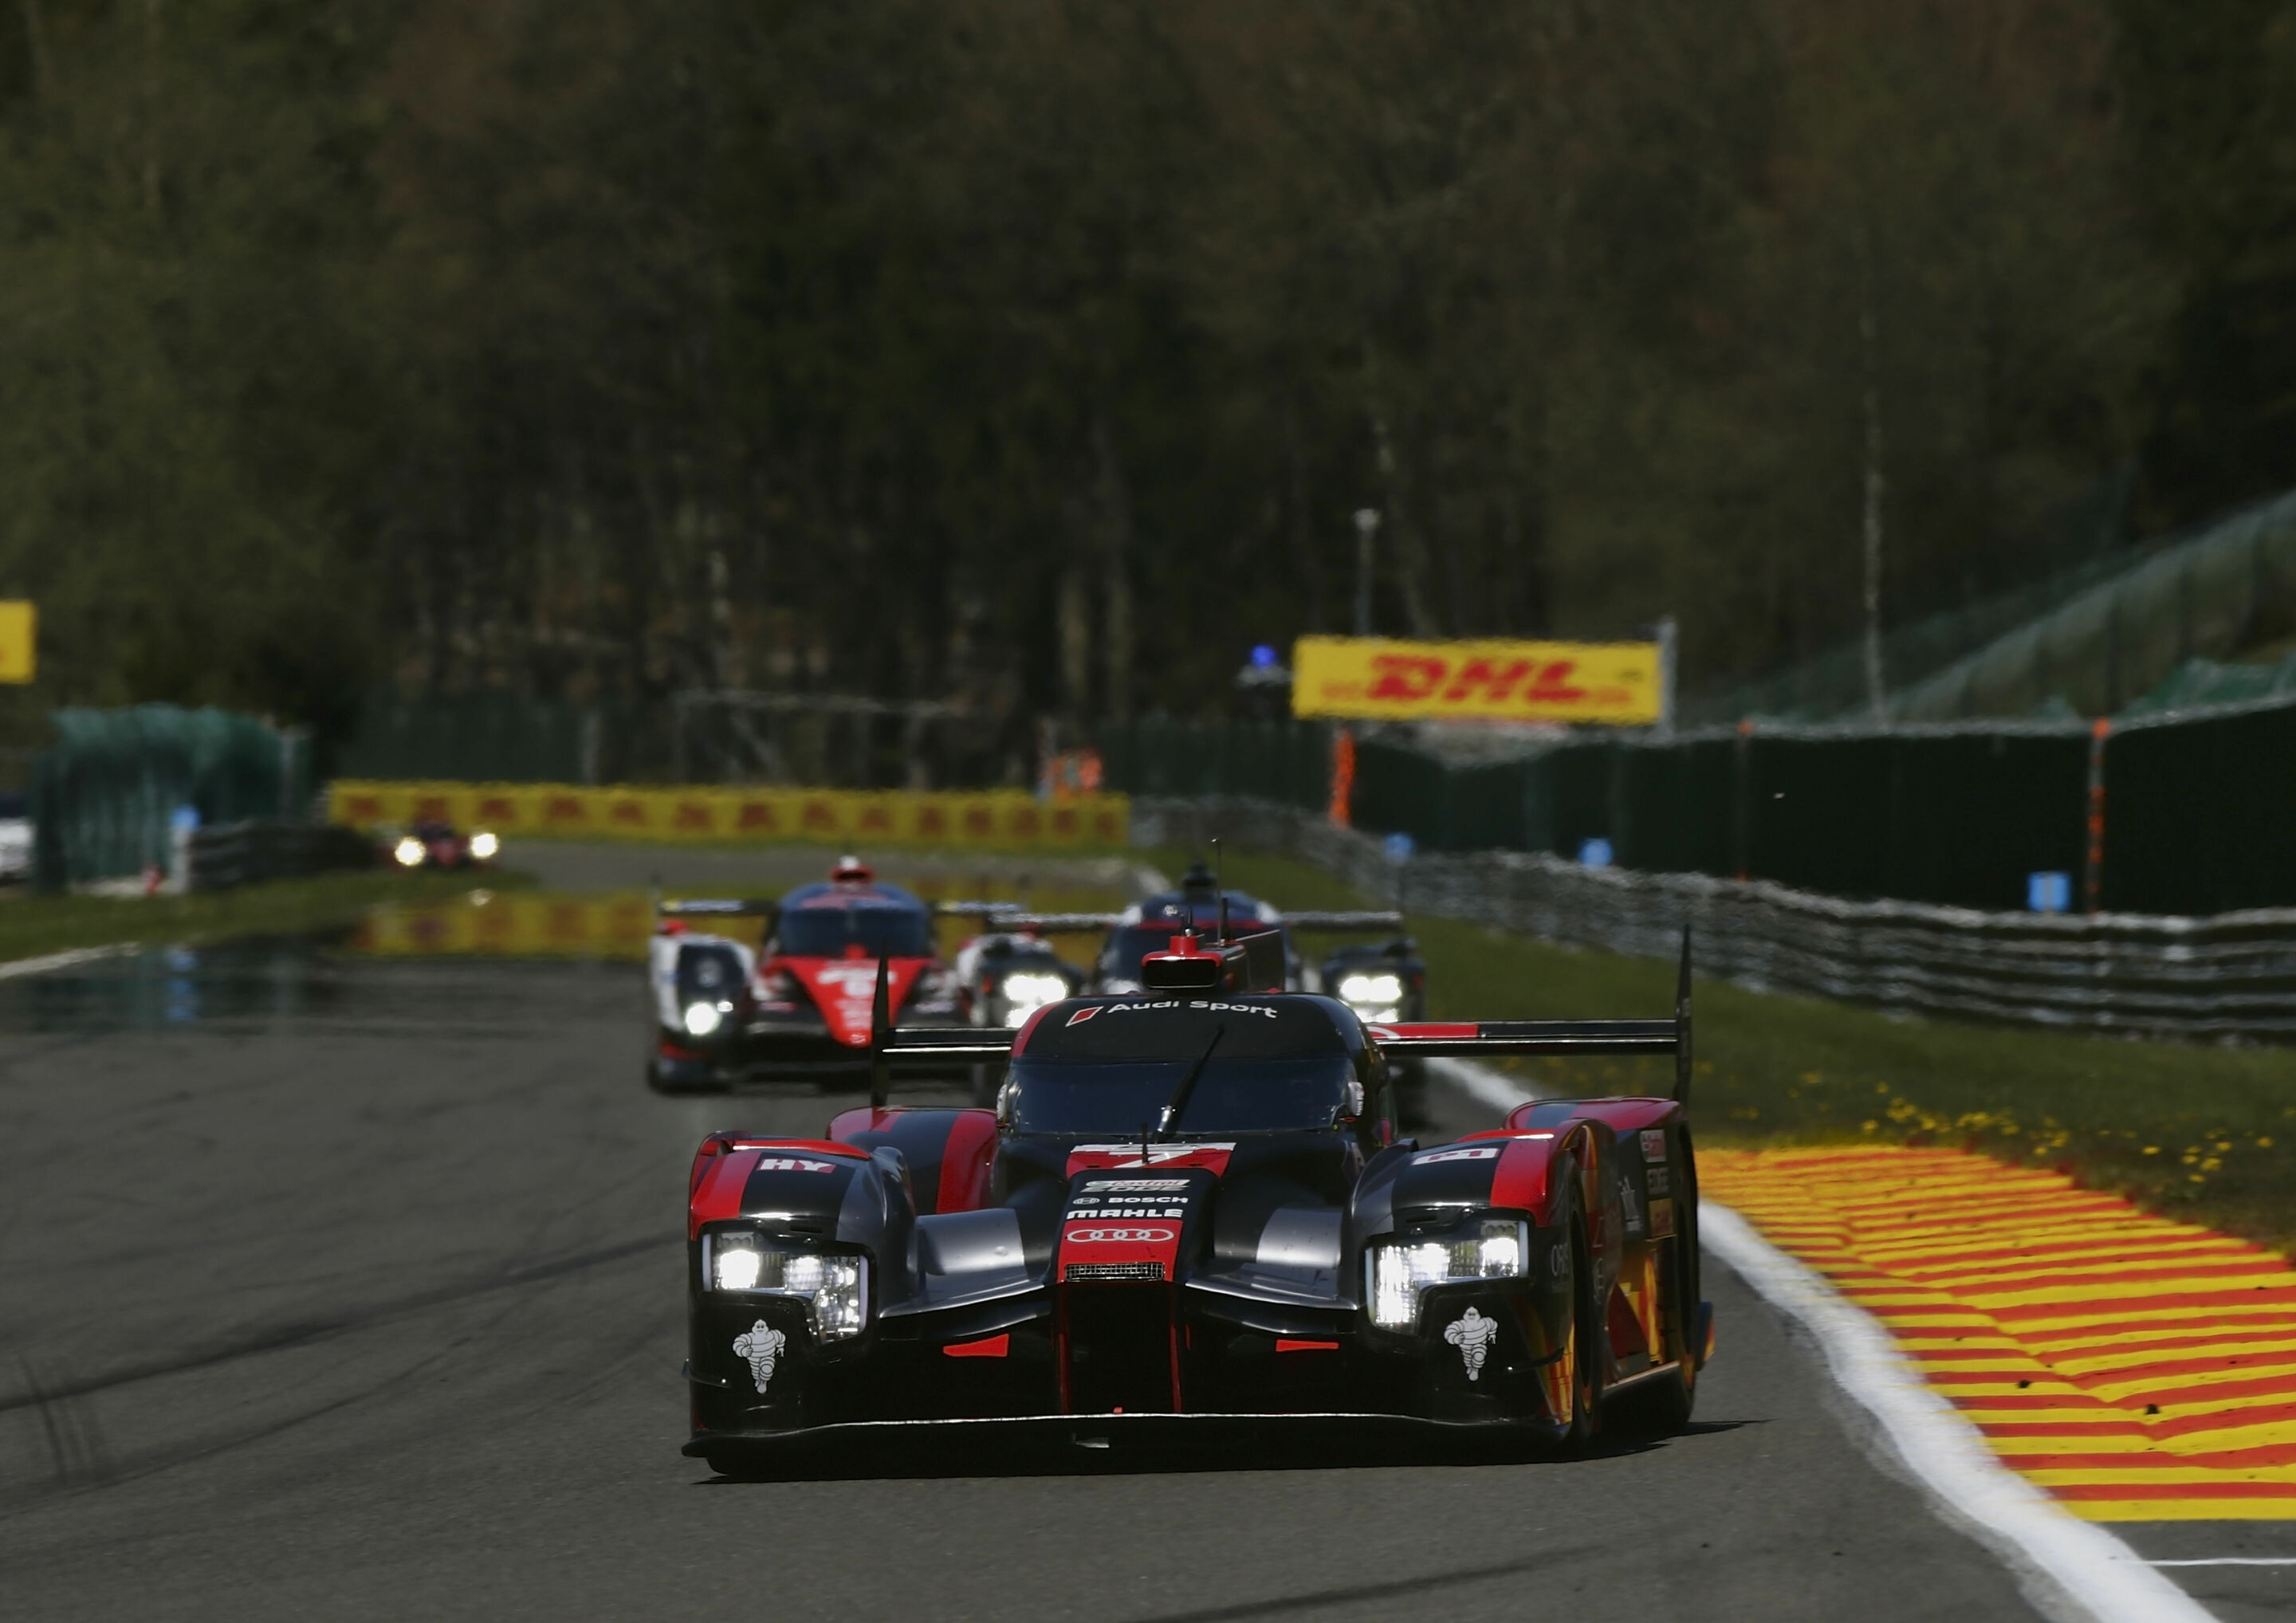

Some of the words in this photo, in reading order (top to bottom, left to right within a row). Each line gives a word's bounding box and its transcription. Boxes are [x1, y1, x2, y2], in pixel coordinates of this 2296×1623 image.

[1365, 654, 1586, 700] DHL
[1107, 1000, 1180, 1014] Audi
[1189, 1000, 1279, 1019] Sport
[760, 1158, 832, 1171] HY
[1066, 1208, 1184, 1220] MAHLE
